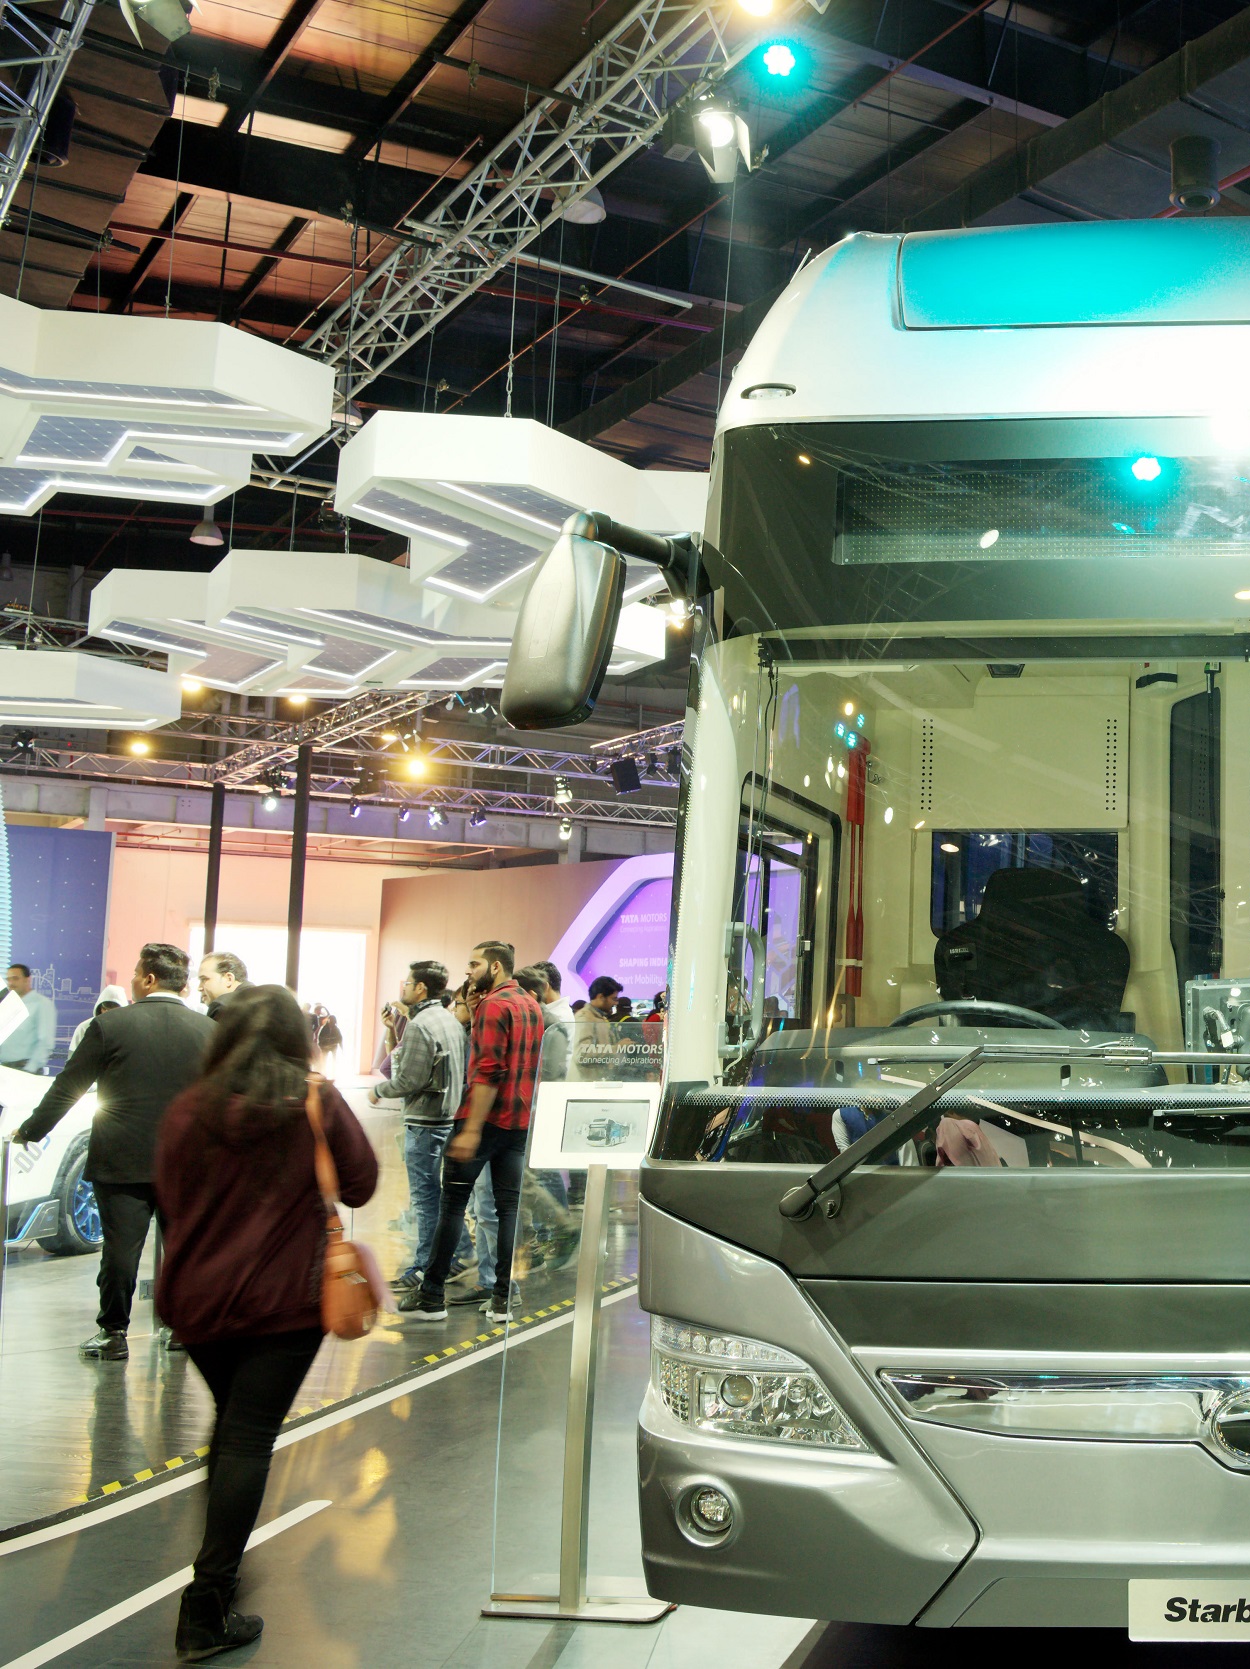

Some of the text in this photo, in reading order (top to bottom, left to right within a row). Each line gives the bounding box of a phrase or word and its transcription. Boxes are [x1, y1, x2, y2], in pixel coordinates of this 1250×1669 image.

[620, 912, 668, 924] TATA MOTORS
[619, 957, 649, 968] SHAPING
[613, 974, 634, 985] Smart
[578, 1043, 663, 1054] TATA MOTORS
[578, 1056, 662, 1066] Connecting Aspirations
